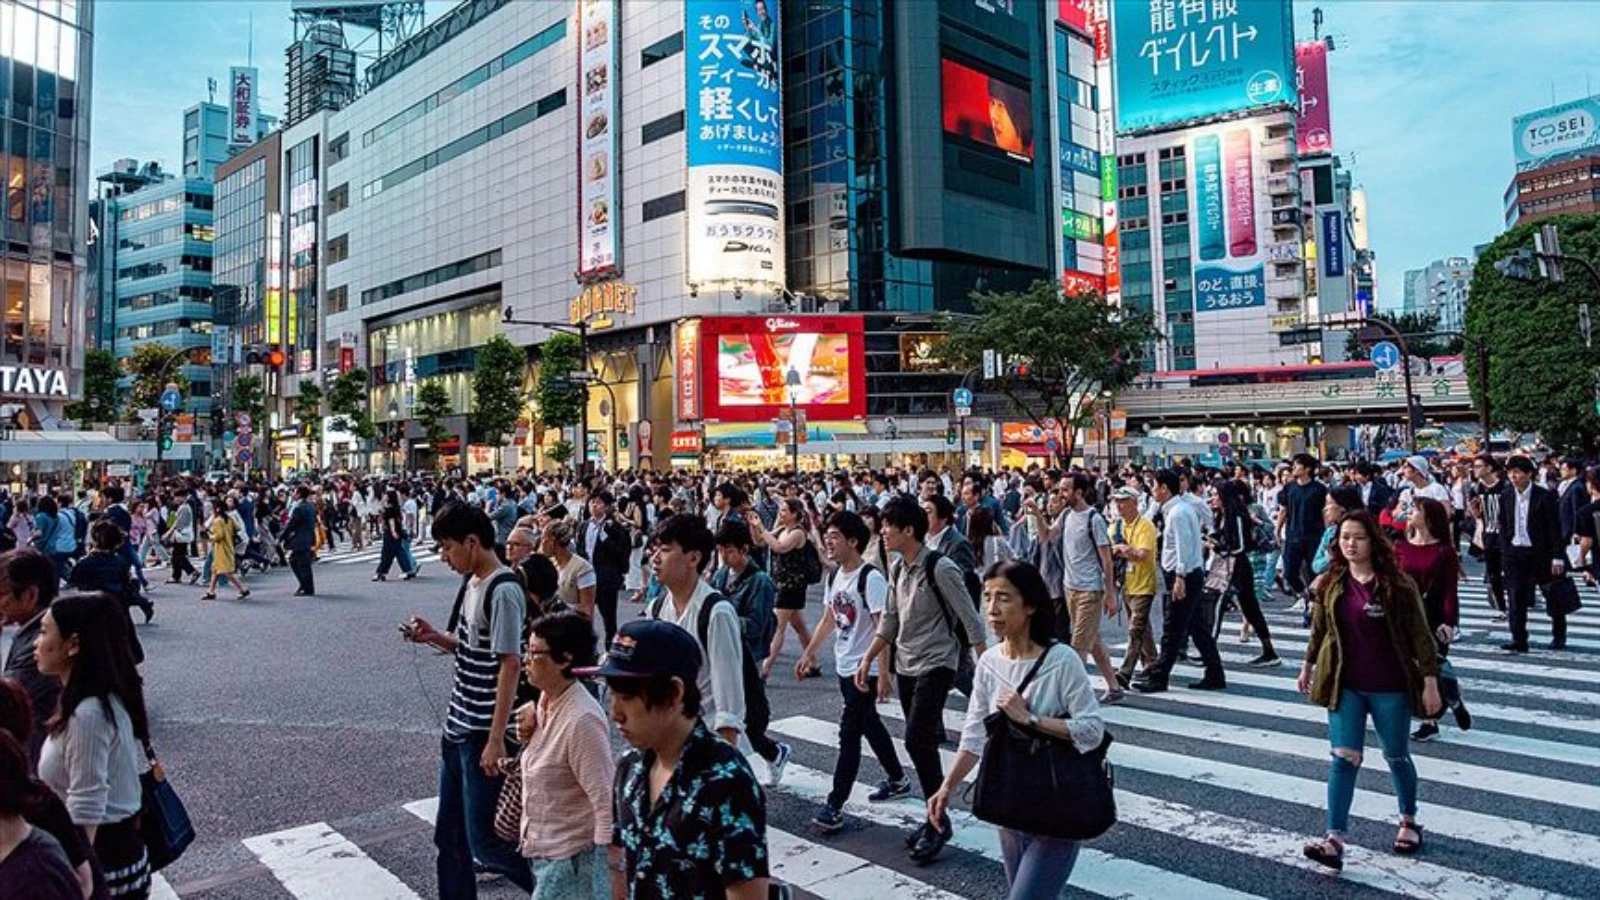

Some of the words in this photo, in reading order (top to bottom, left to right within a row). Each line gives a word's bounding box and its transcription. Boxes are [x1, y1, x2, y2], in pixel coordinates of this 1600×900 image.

[698, 14, 731, 30] その
[1138, 22, 1258, 75] ダイレクト
[235, 73, 251, 129] 大和証券
[699, 86, 779, 128] 軽くして
[699, 123, 778, 147] あげましょう
[1529, 115, 1585, 140] TOSEI
[1198, 276, 1264, 292] のど、直接、
[1205, 291, 1255, 308] うるおう
[0, 366, 68, 396] TAYA
[1322, 384, 1342, 397] JR
